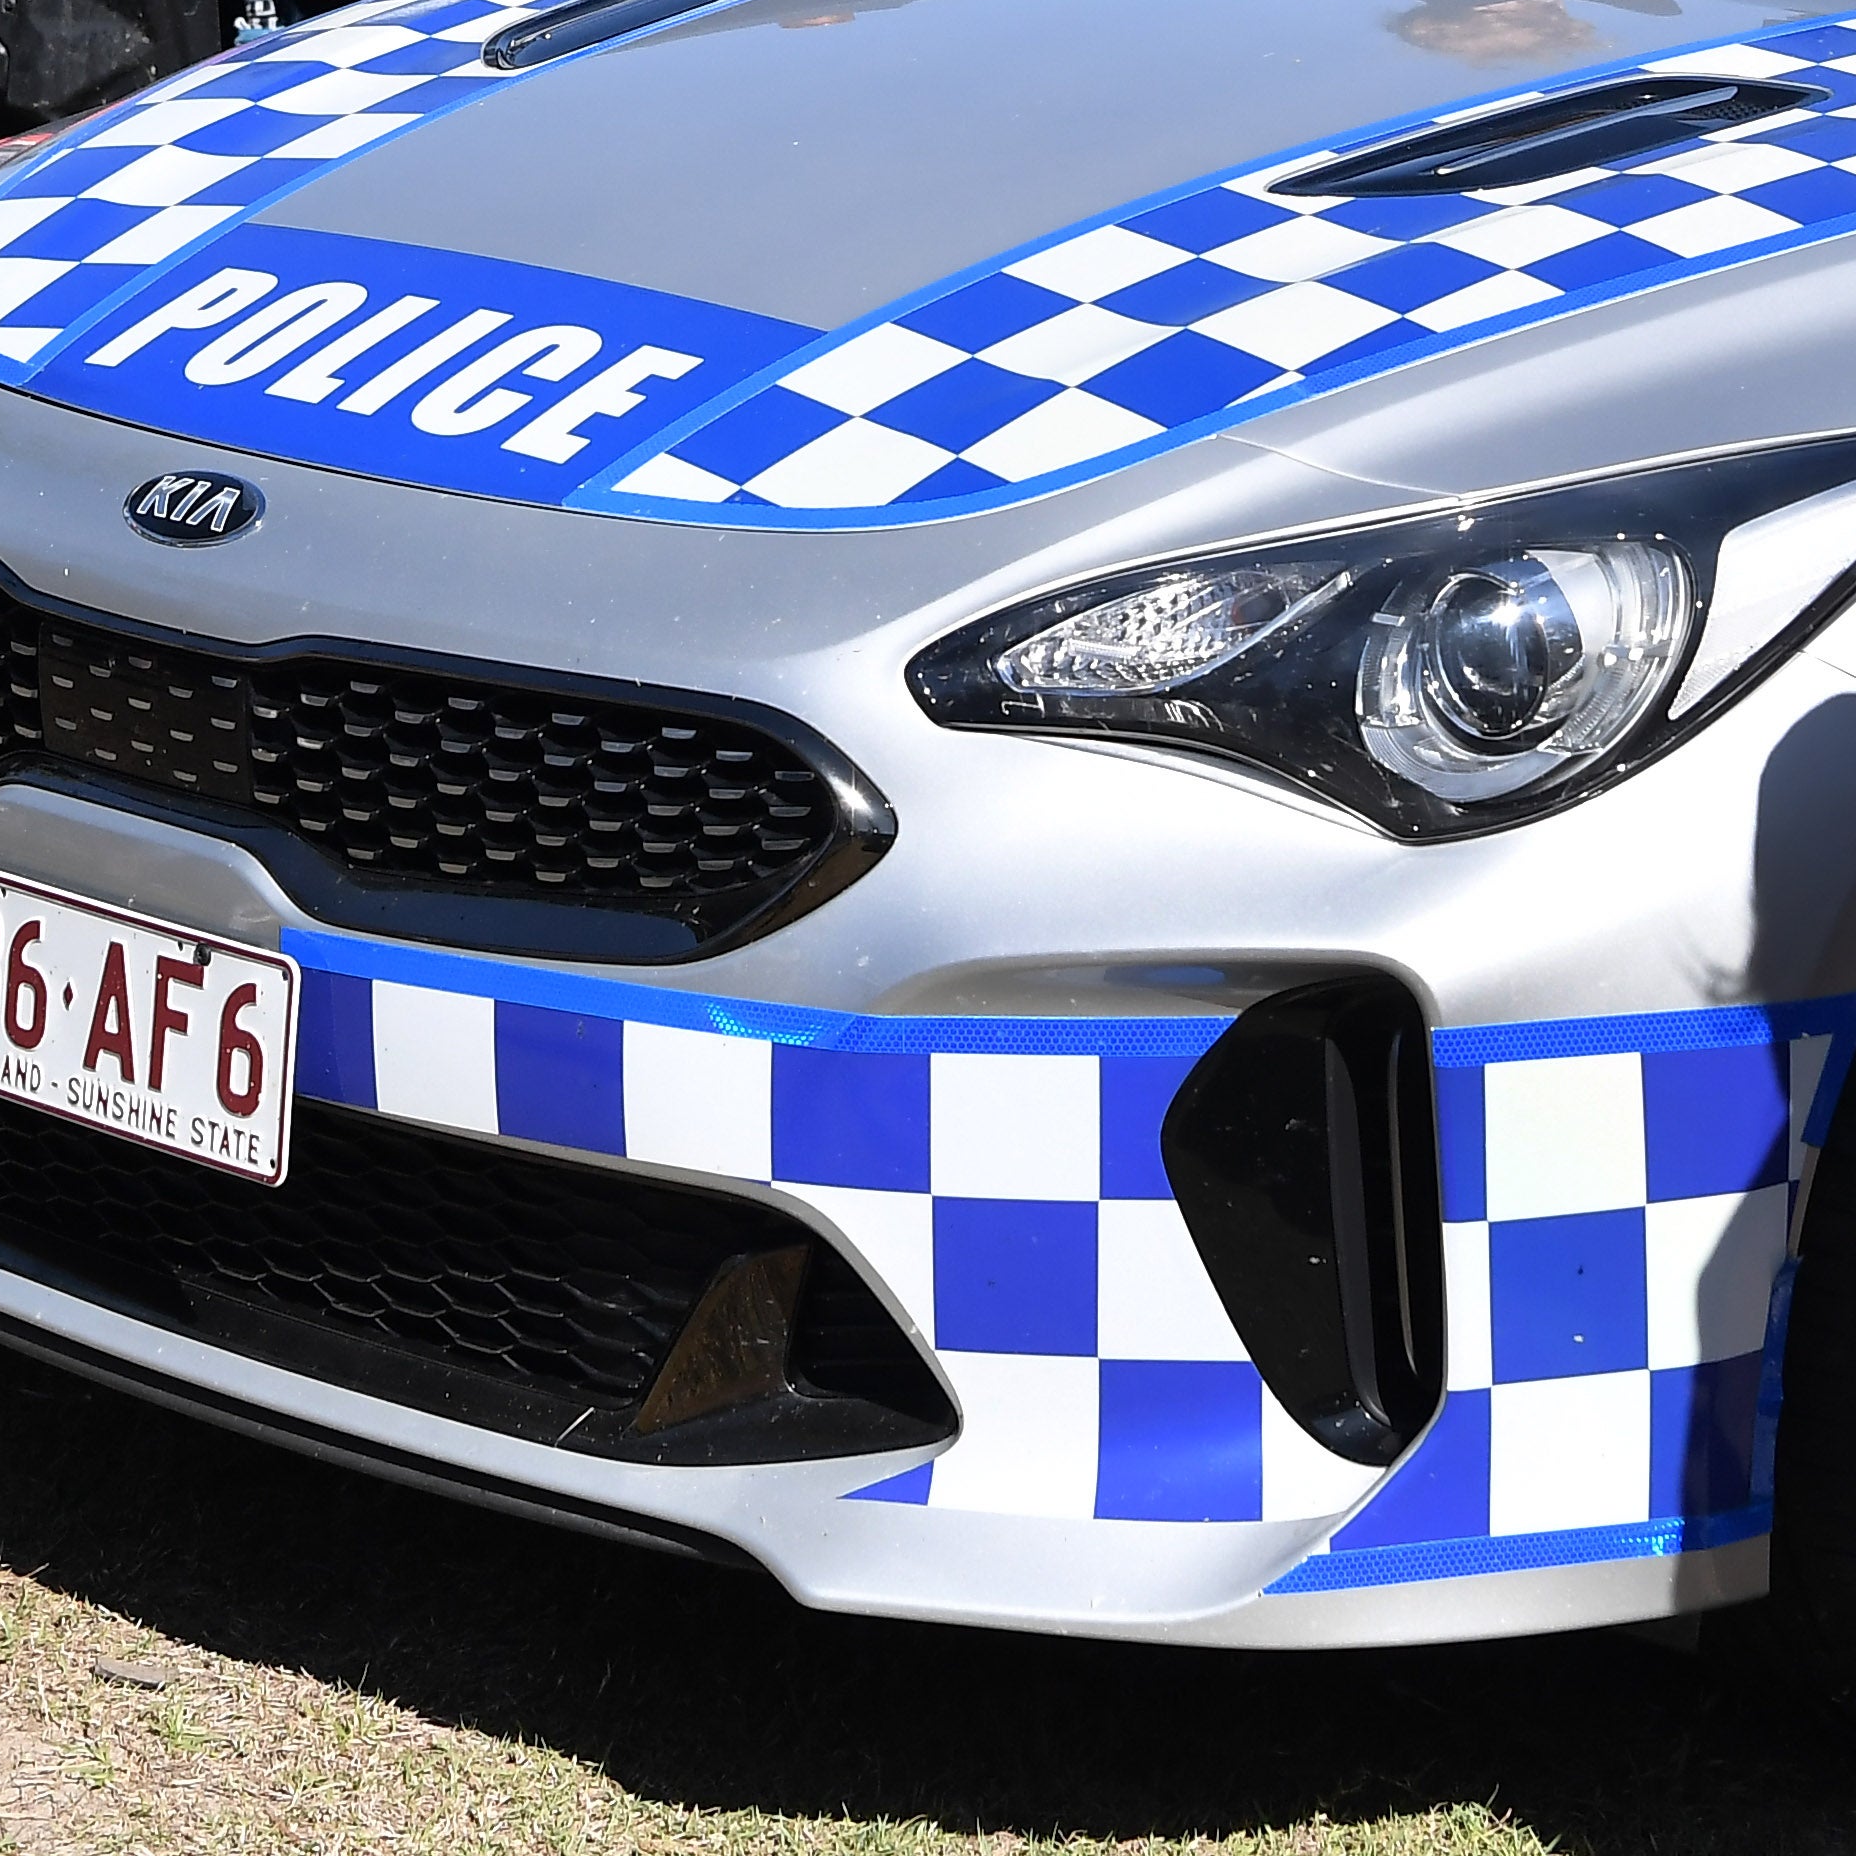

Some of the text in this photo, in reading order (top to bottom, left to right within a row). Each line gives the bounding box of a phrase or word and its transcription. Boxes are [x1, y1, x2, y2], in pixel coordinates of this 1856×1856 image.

[84, 267, 704, 464] POLICE
[136, 475, 241, 532] KIA
[67, 1077, 177, 1140] SUNSHINE
[191, 1116, 260, 1165] STATE
